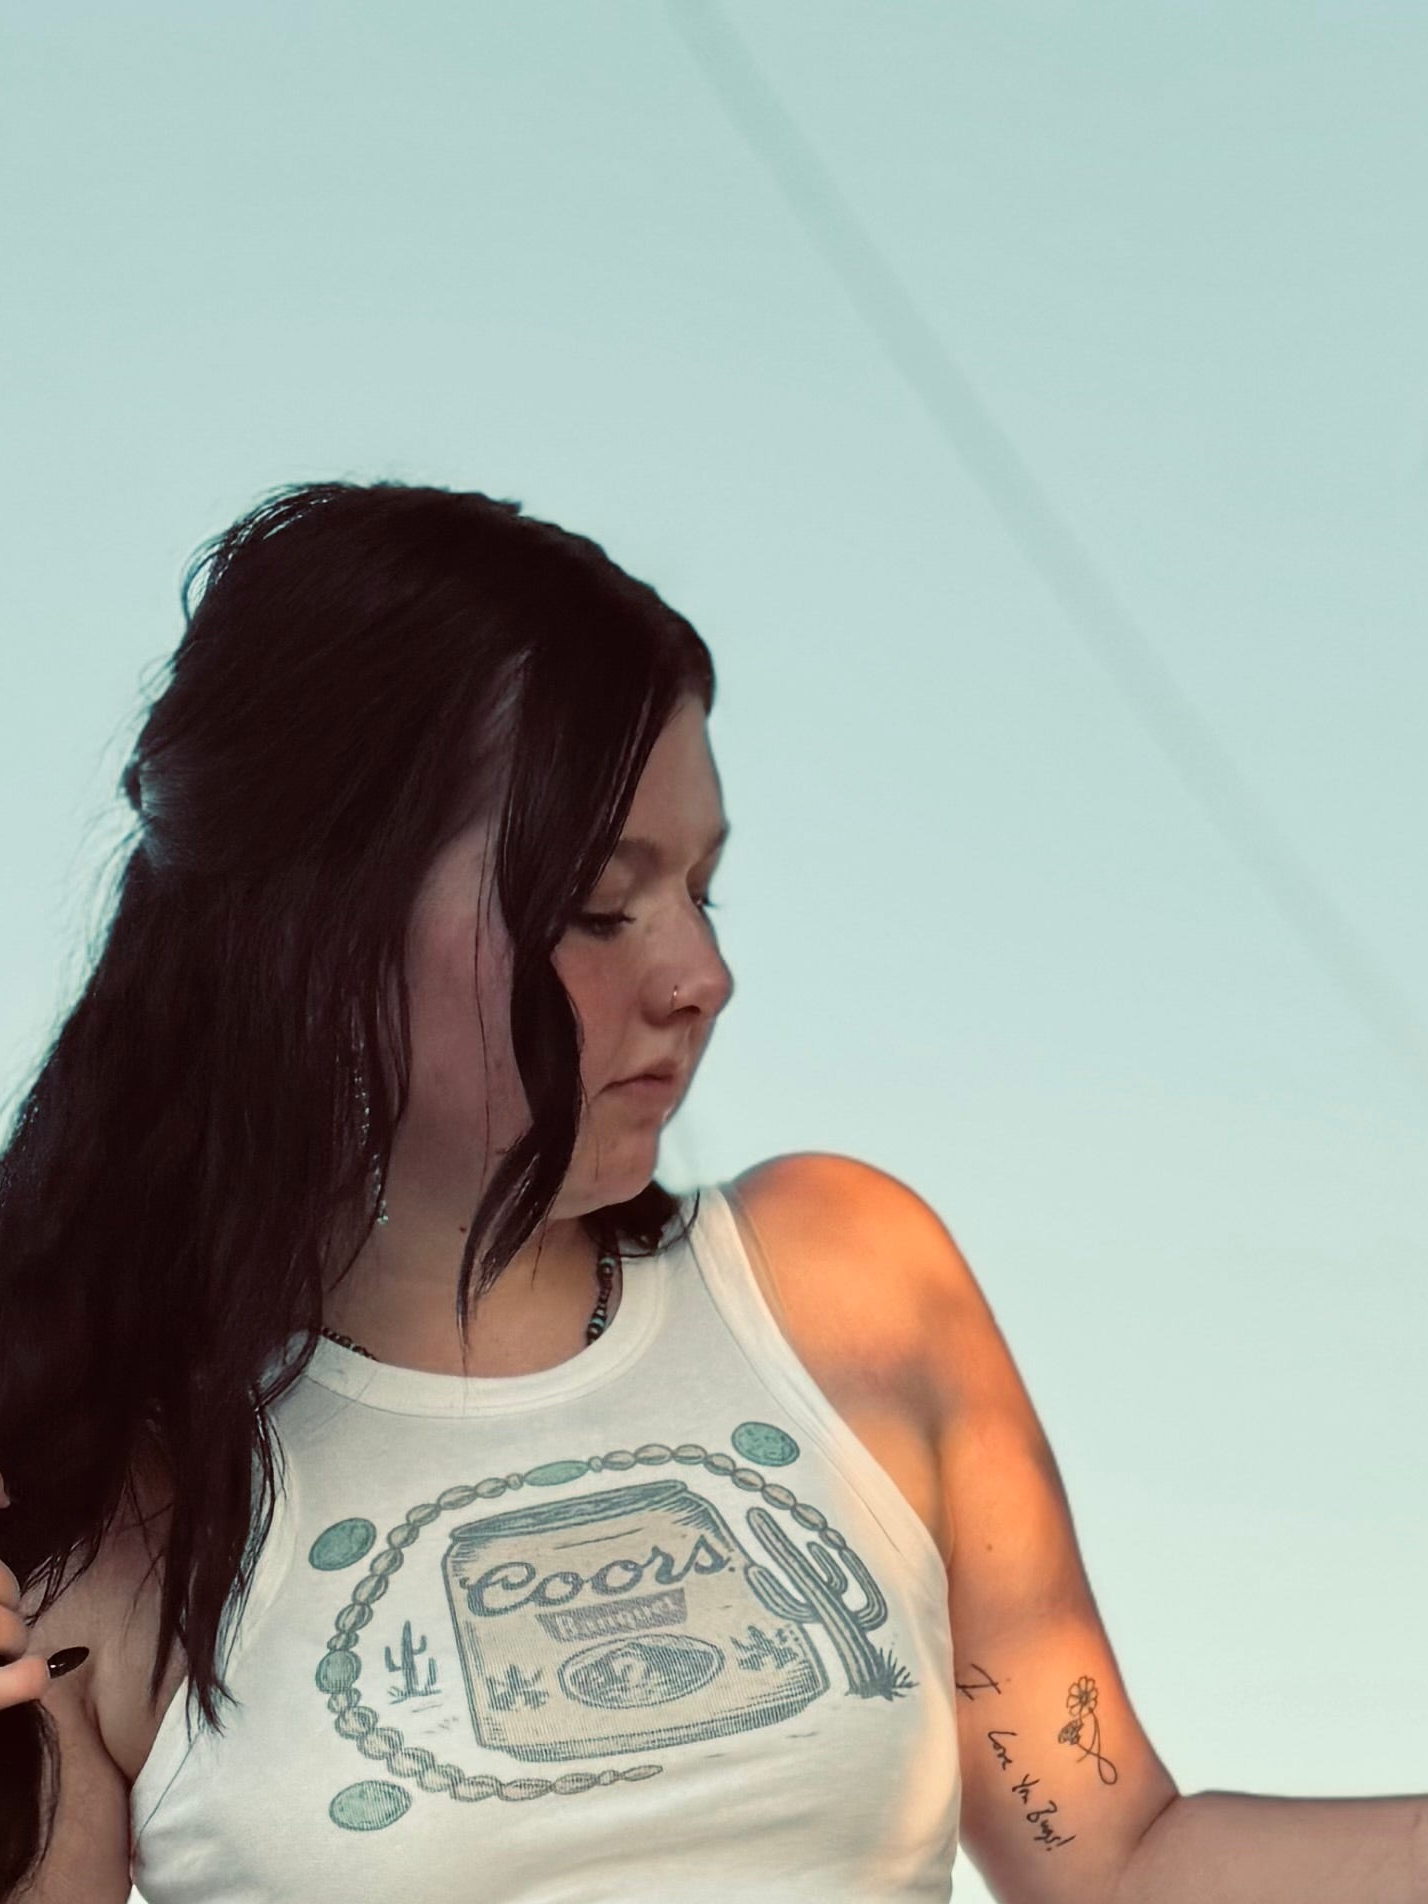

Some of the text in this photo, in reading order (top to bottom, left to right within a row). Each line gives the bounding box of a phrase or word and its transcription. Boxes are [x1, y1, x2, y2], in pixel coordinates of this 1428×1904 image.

[459, 1534, 732, 1617] Coors
[956, 1664, 1001, 1701] I
[987, 1730, 1017, 1771] Love
